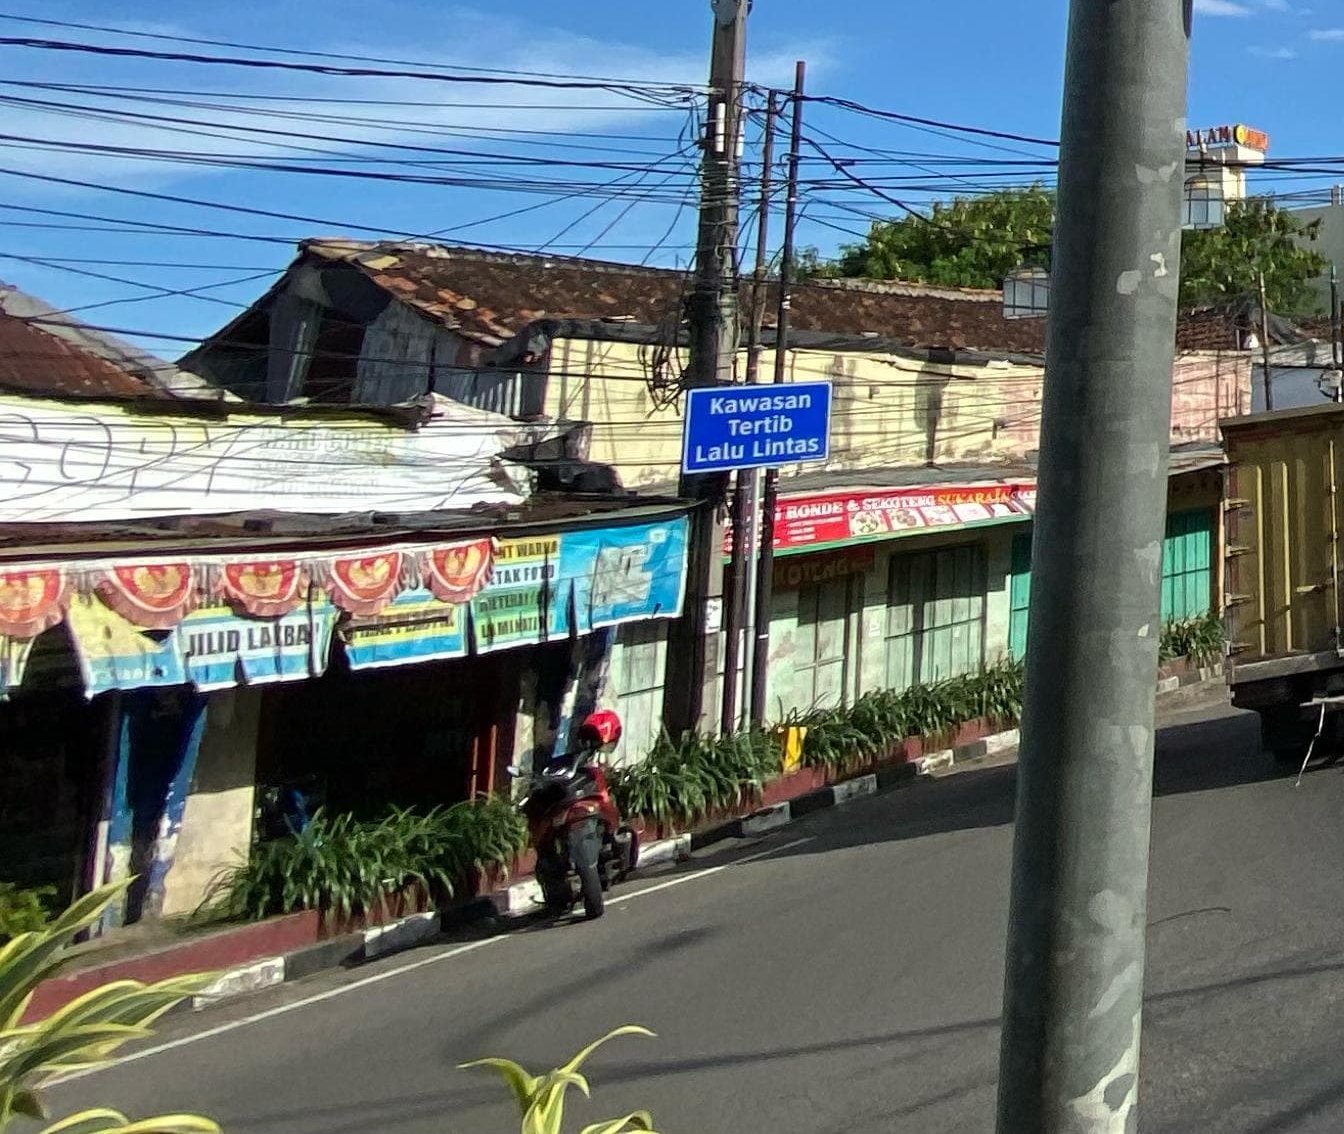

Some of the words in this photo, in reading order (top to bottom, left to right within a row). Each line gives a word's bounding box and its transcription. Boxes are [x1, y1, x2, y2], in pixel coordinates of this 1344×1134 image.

[710, 393, 812, 415] Kawasan
[728, 415, 793, 436] Tertib
[695, 442, 745, 463] Lalu
[752, 436, 820, 458] Lintas
[785, 501, 844, 520] RONDE
[847, 499, 860, 512] &
[862, 494, 937, 511] SEKOTENG
[184, 630, 240, 658] JILID
